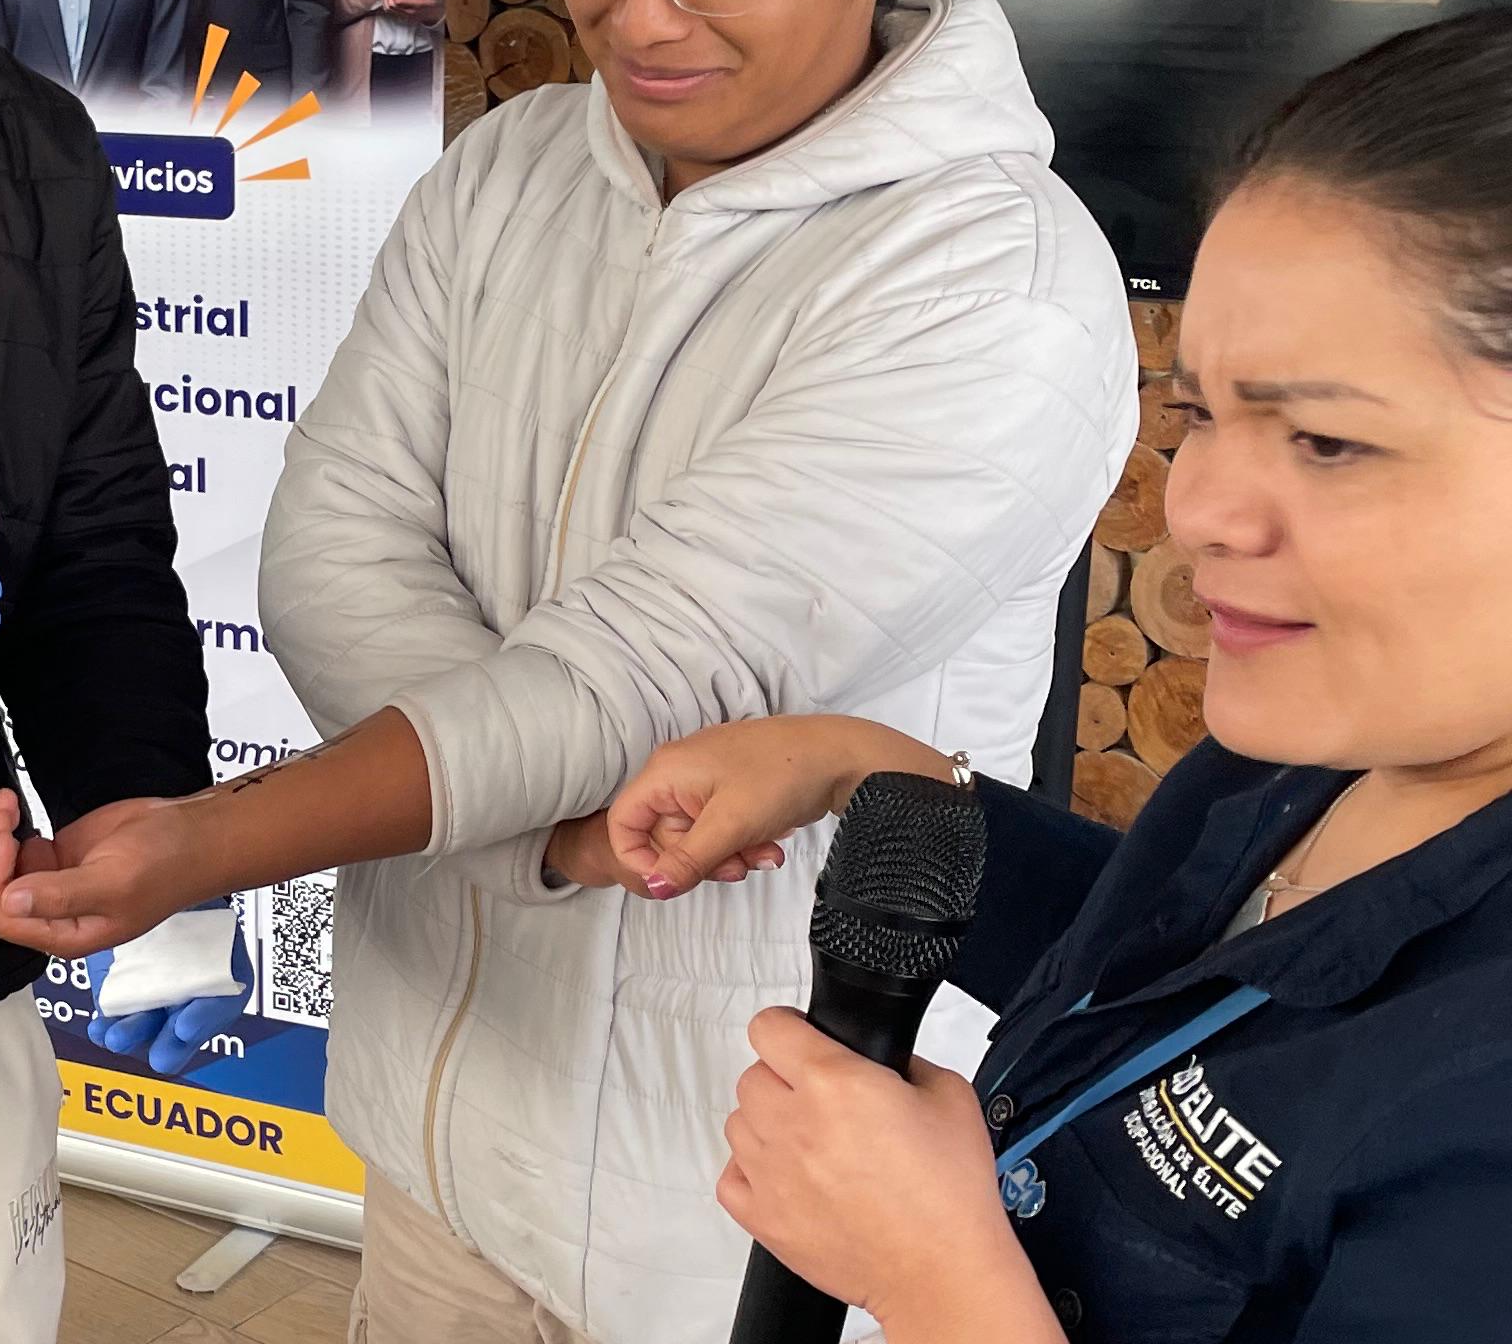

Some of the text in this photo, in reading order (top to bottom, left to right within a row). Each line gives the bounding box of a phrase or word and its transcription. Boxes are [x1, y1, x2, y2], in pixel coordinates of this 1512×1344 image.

[110, 160, 214, 193] vicios
[1129, 278, 1161, 290] TCL
[144, 375, 296, 422] cional
[196, 619, 270, 652] rm
[84, 1082, 284, 1155] ECUADOR
[1179, 1083, 1282, 1191] ELITE
[1173, 1144, 1194, 1172] DE
[1192, 1165, 1247, 1219] ÉLITE
